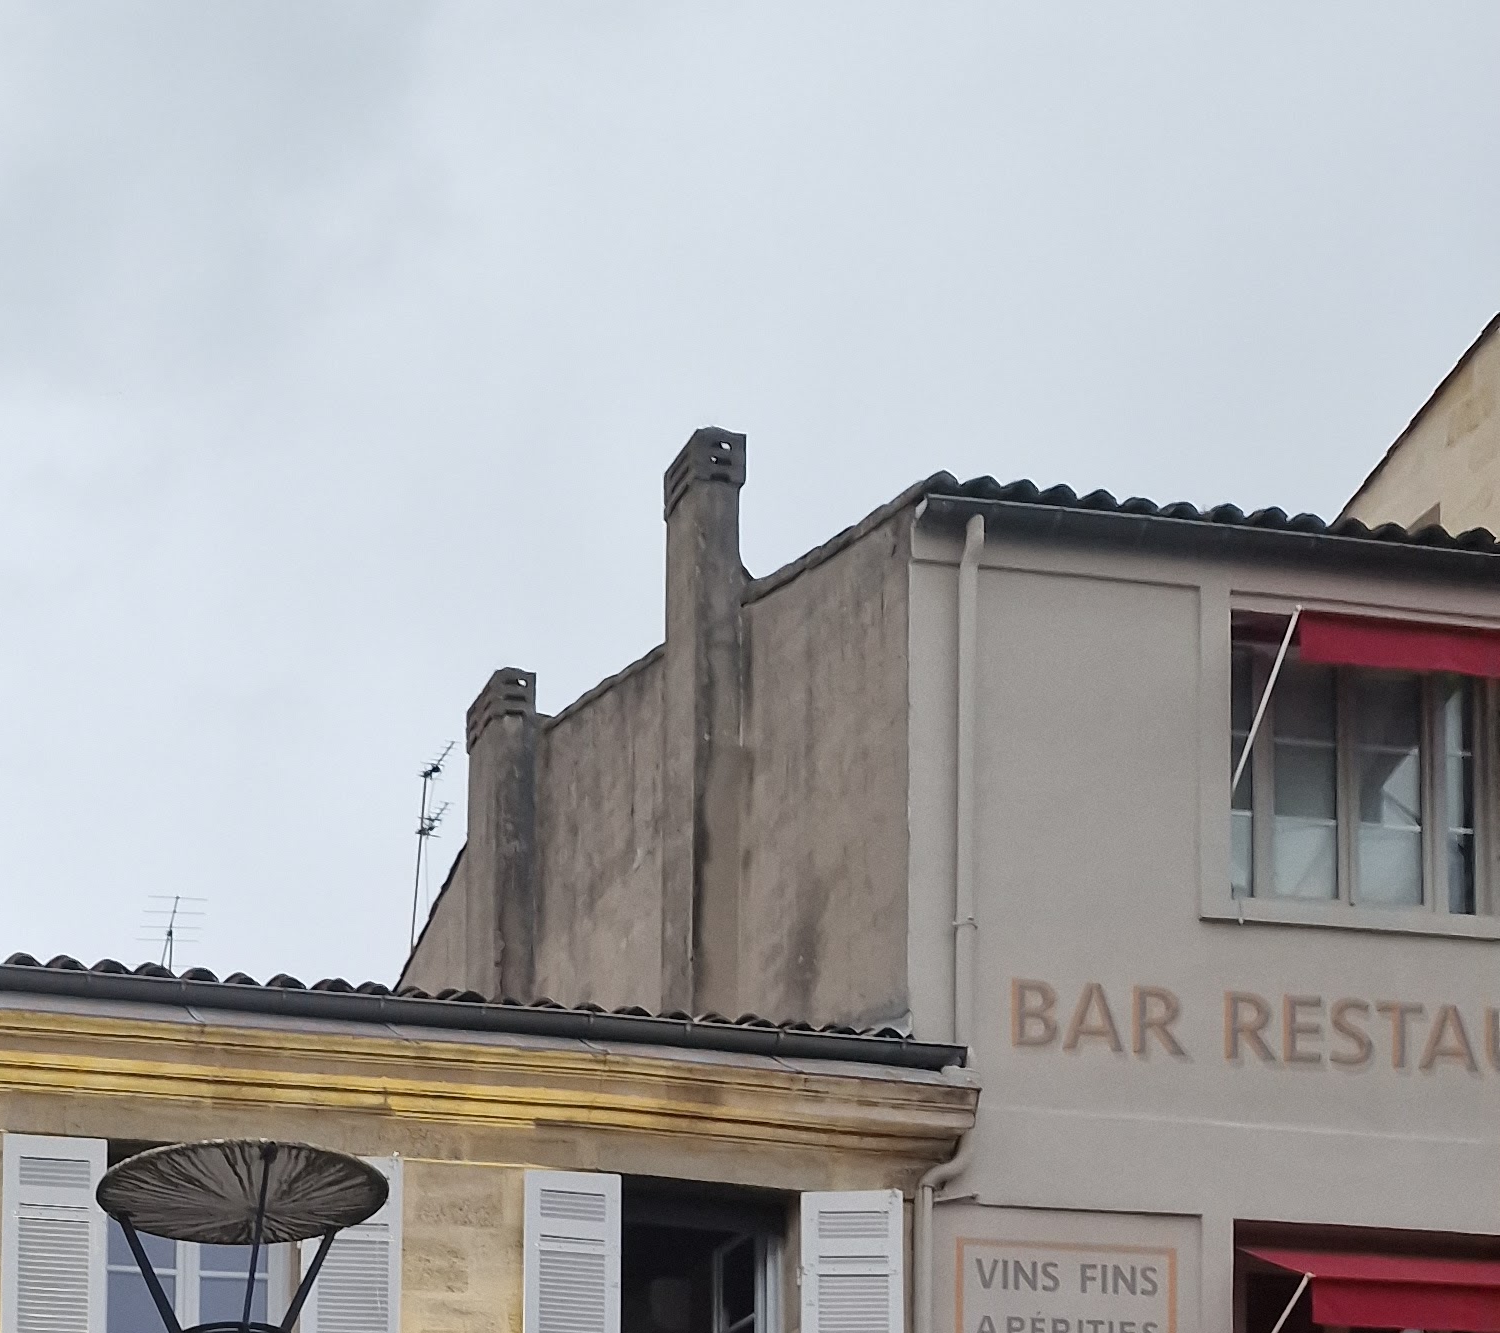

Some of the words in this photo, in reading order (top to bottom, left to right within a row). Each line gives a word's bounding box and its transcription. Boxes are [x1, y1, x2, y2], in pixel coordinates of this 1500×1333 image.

[1010, 976, 1190, 1062] BAR
[1222, 989, 1500, 1076] RESTA
[975, 1257, 1060, 1293] VINS
[1079, 1262, 1159, 1297] FINS
